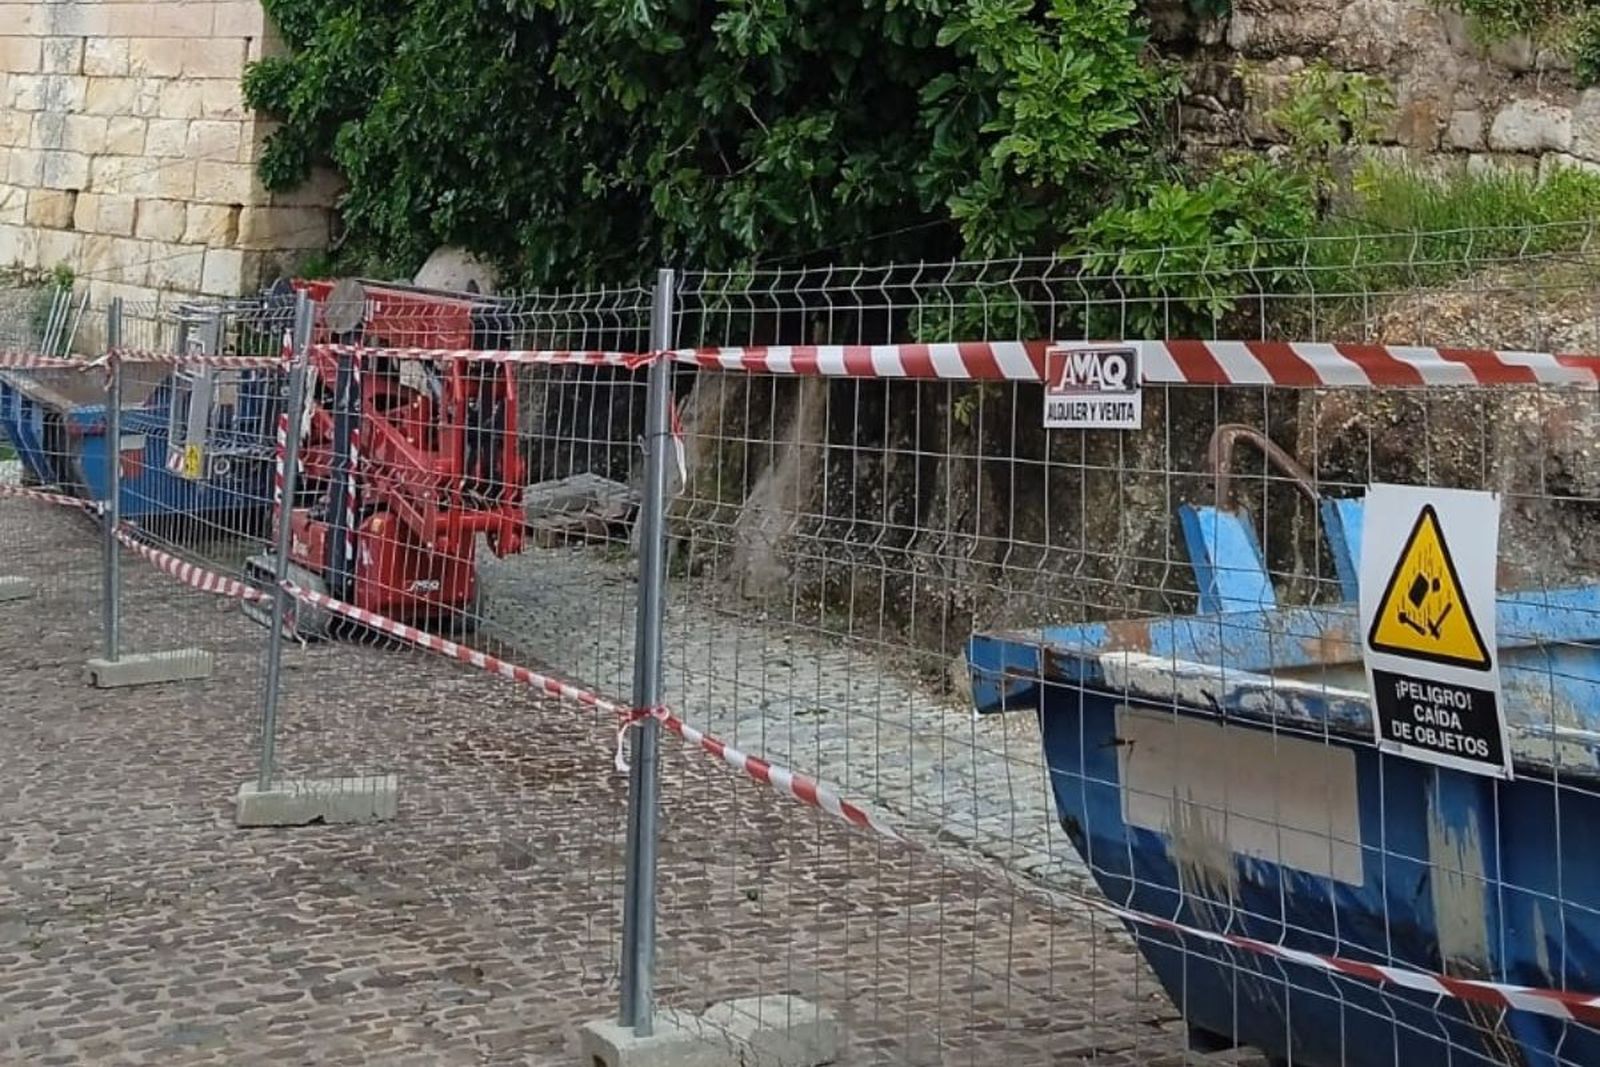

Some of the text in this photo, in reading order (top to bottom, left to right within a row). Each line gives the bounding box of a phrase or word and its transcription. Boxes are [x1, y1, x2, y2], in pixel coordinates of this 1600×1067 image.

[1051, 352, 1127, 392] AMAQ
[1048, 402, 1135, 421] ALQUILER Y VENTA
[1395, 680, 1472, 710] ¡PELIGRO!
[1413, 704, 1462, 731] CAÍDA
[1392, 719, 1489, 757] DE OBJETOS
